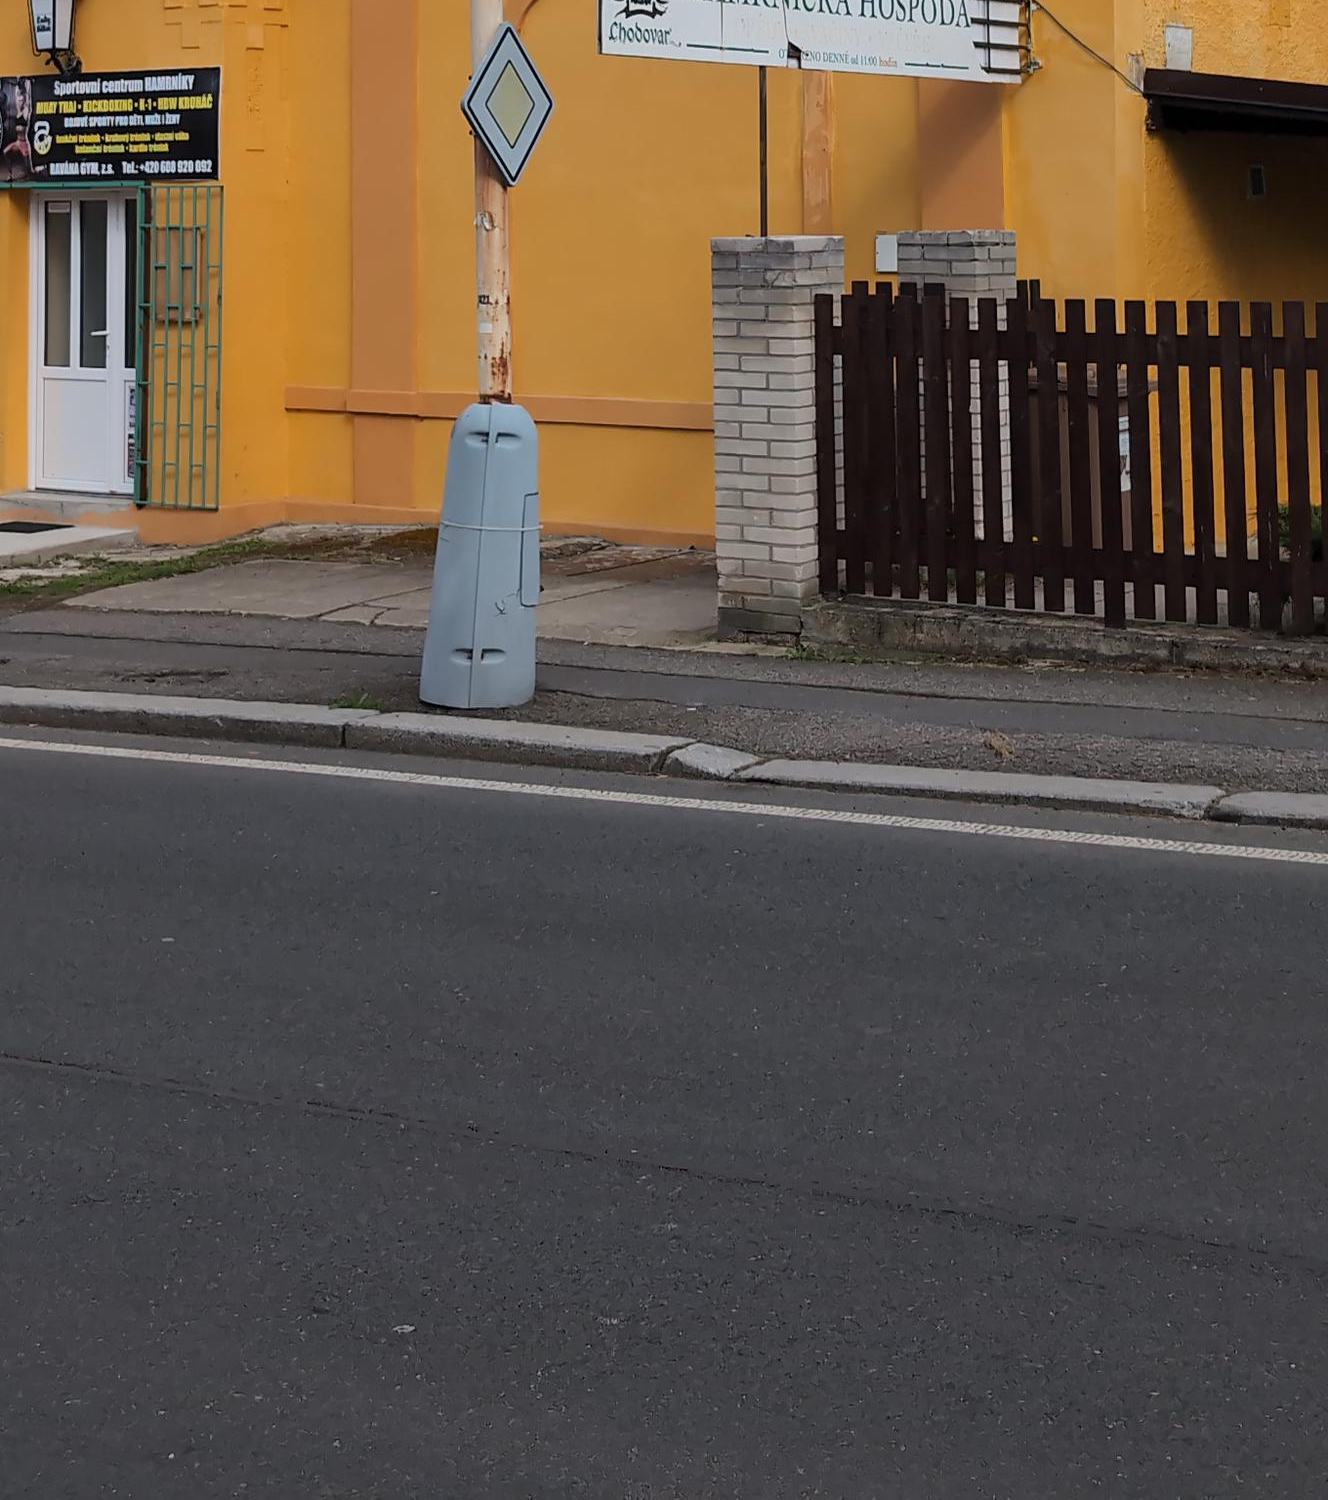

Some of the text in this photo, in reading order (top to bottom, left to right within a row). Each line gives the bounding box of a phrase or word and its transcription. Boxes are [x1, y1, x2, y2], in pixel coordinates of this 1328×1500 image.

[609, 20, 670, 46] Chodovar
[54, 77, 101, 97] Sportovní
[102, 78, 143, 94] centrum
[82, 98, 134, 113] KICKBOXING
